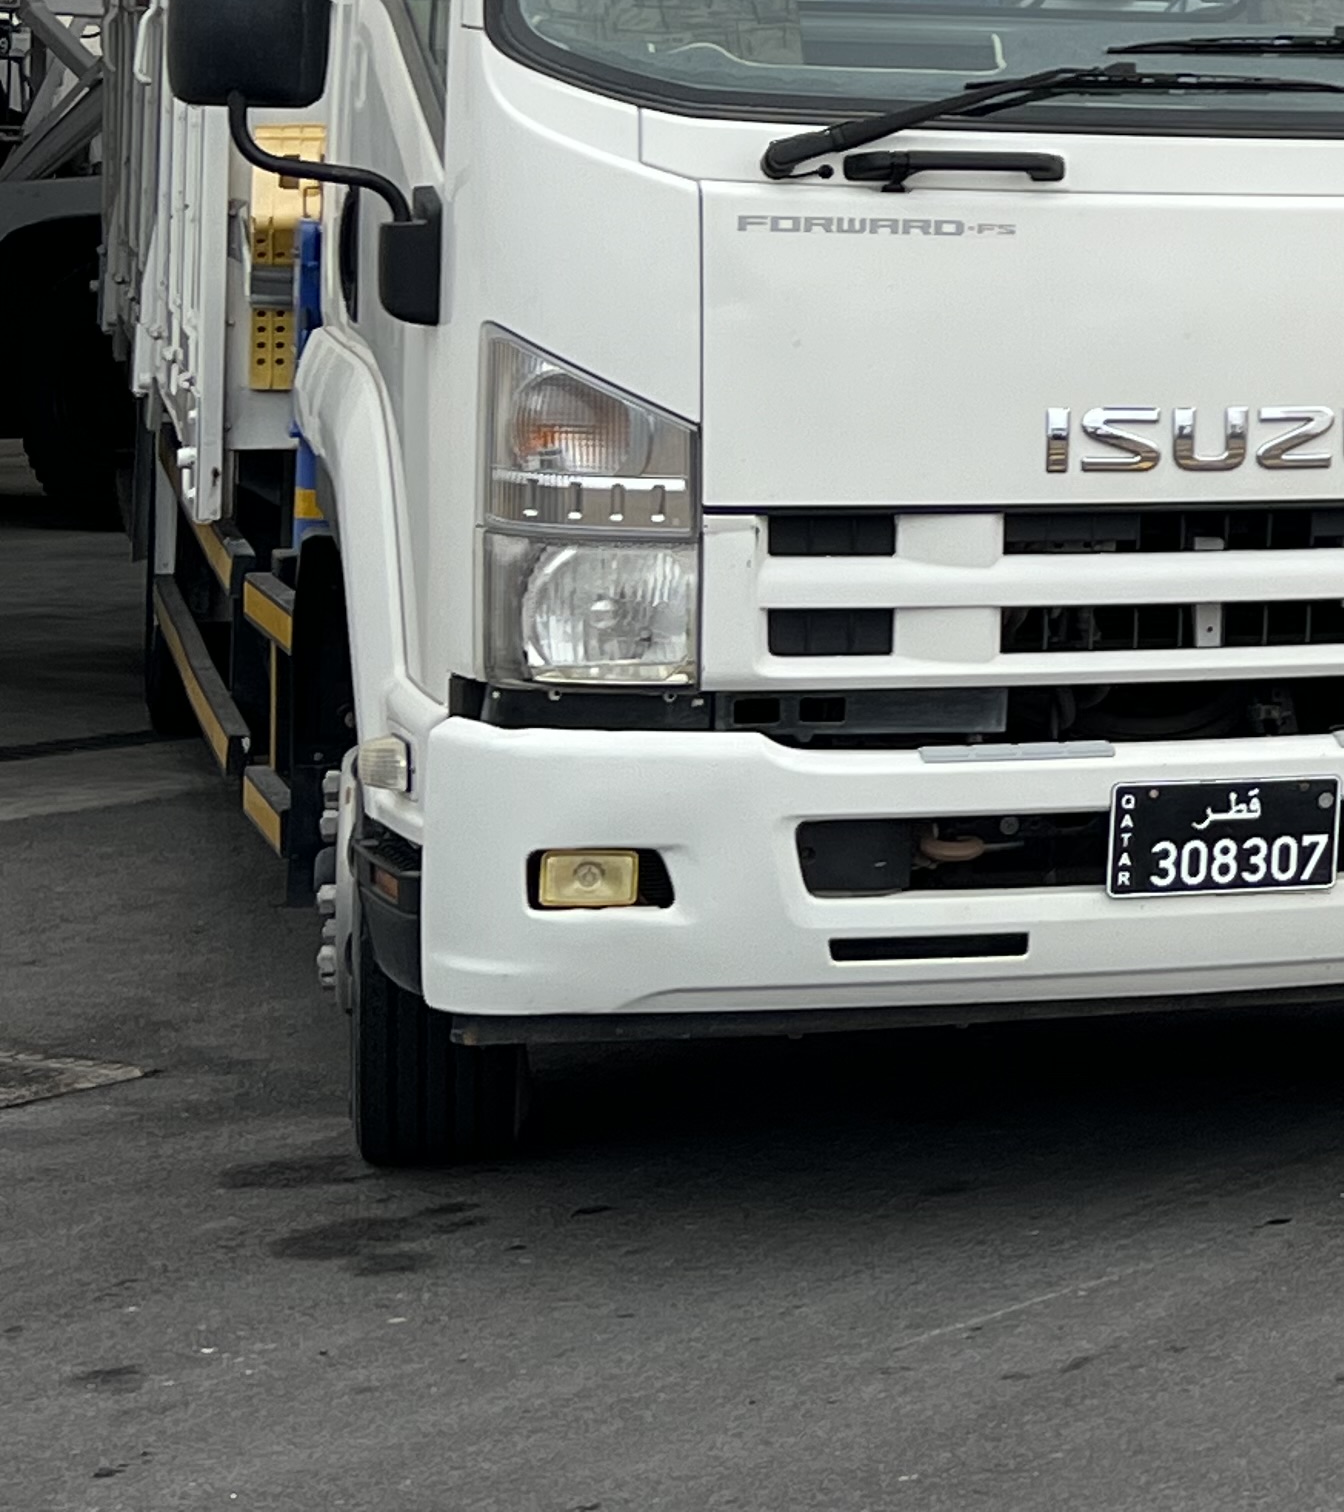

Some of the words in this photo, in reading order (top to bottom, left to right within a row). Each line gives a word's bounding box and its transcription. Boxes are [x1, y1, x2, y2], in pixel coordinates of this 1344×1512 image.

[1191, 788, 1262, 830] قطر
[1117, 794, 1136, 886] QATAR
[1150, 833, 1330, 887] 308307
